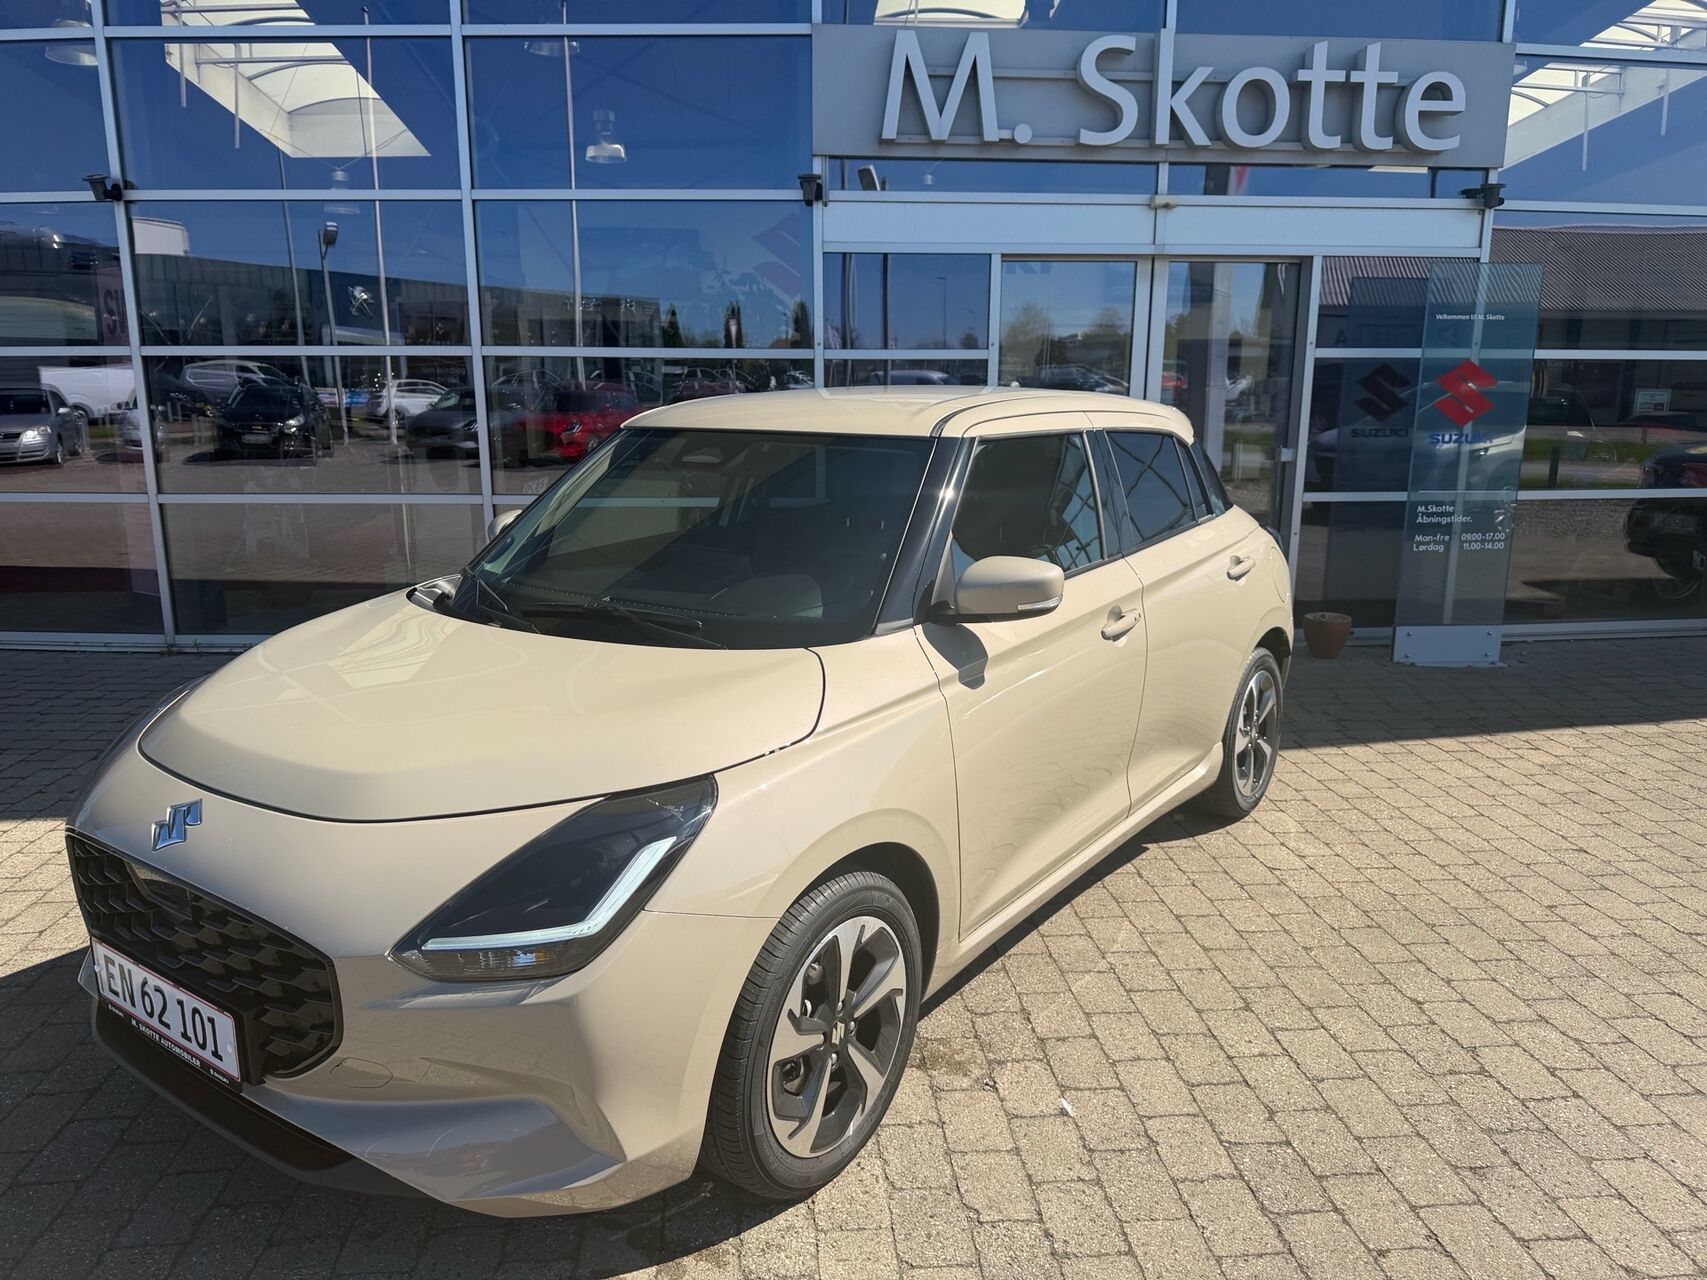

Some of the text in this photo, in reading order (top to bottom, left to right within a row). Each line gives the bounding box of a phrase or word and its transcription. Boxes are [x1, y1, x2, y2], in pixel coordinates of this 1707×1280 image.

[879, 28, 1467, 153] M. Skotte
[1429, 432, 1493, 444] SUZU
[1416, 504, 1455, 513] M.Skotte
[1415, 513, 1473, 524] Åbningstider.
[1414, 533, 1450, 542] Man-fre
[103, 953, 224, 1063] EN 62 101
[138, 1022, 160, 1042] SKOTTE
[161, 1036, 201, 1067] AUTOMOBILER
